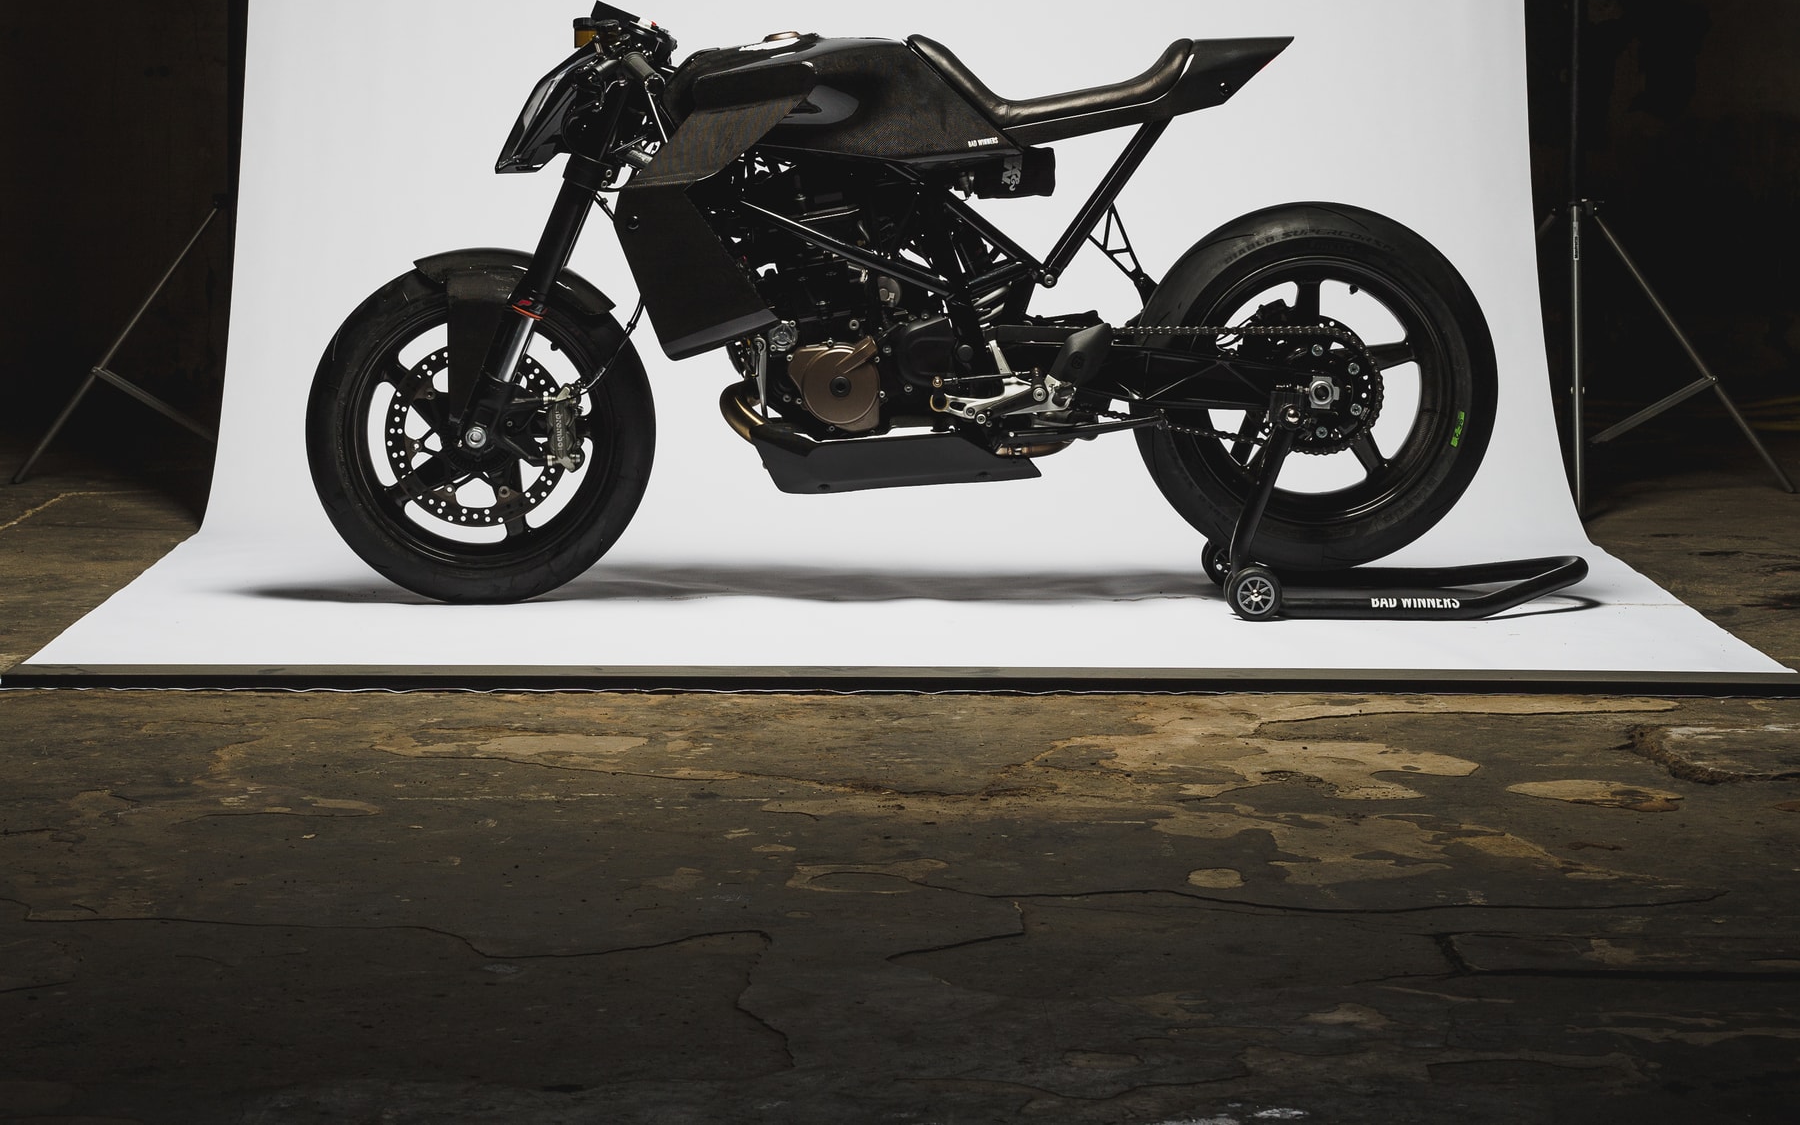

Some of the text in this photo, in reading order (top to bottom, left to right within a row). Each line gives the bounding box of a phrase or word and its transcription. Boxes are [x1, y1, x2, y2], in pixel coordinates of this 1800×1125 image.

[555, 413, 565, 448] brembo
[1371, 597, 1461, 609] BAD WINNERS
